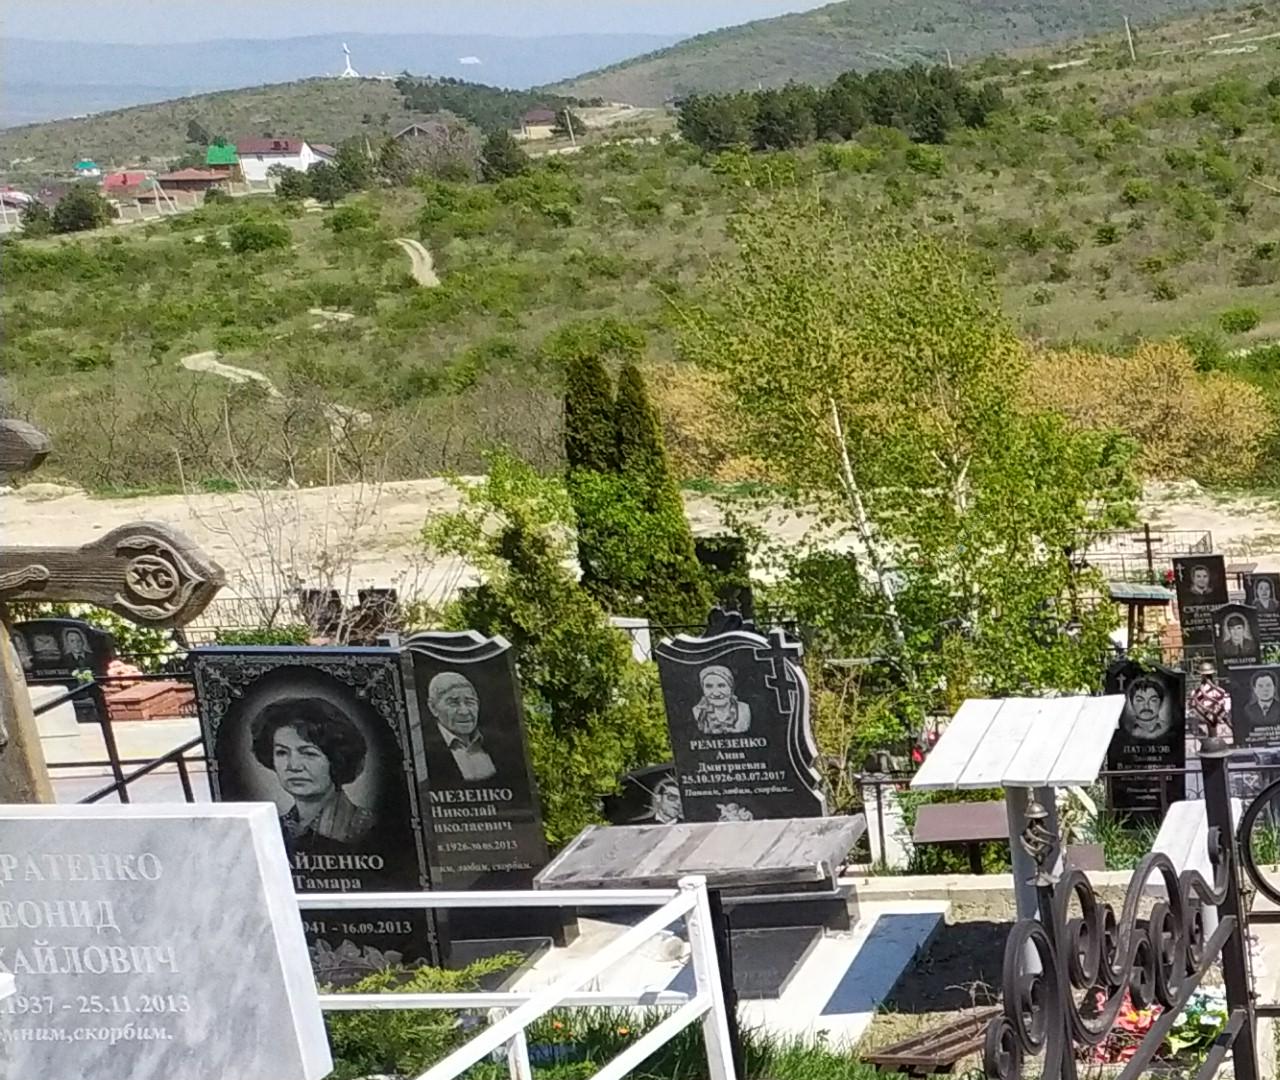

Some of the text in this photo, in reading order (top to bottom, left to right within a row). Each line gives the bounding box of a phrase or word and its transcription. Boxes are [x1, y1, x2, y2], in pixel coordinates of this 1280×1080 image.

[689, 737, 767, 750] РЕМЕЗЕНКО
[716, 751, 746, 760] Анна
[431, 804, 498, 818] Николай
[0, 853, 163, 886] РАТЕНКО
[292, 875, 361, 892] Тамара
[342, 921, 412, 934] 16.09.2013
[77, 995, 190, 1014] 25.11.2013
[0, 1023, 173, 1045] мним,скорбим.
